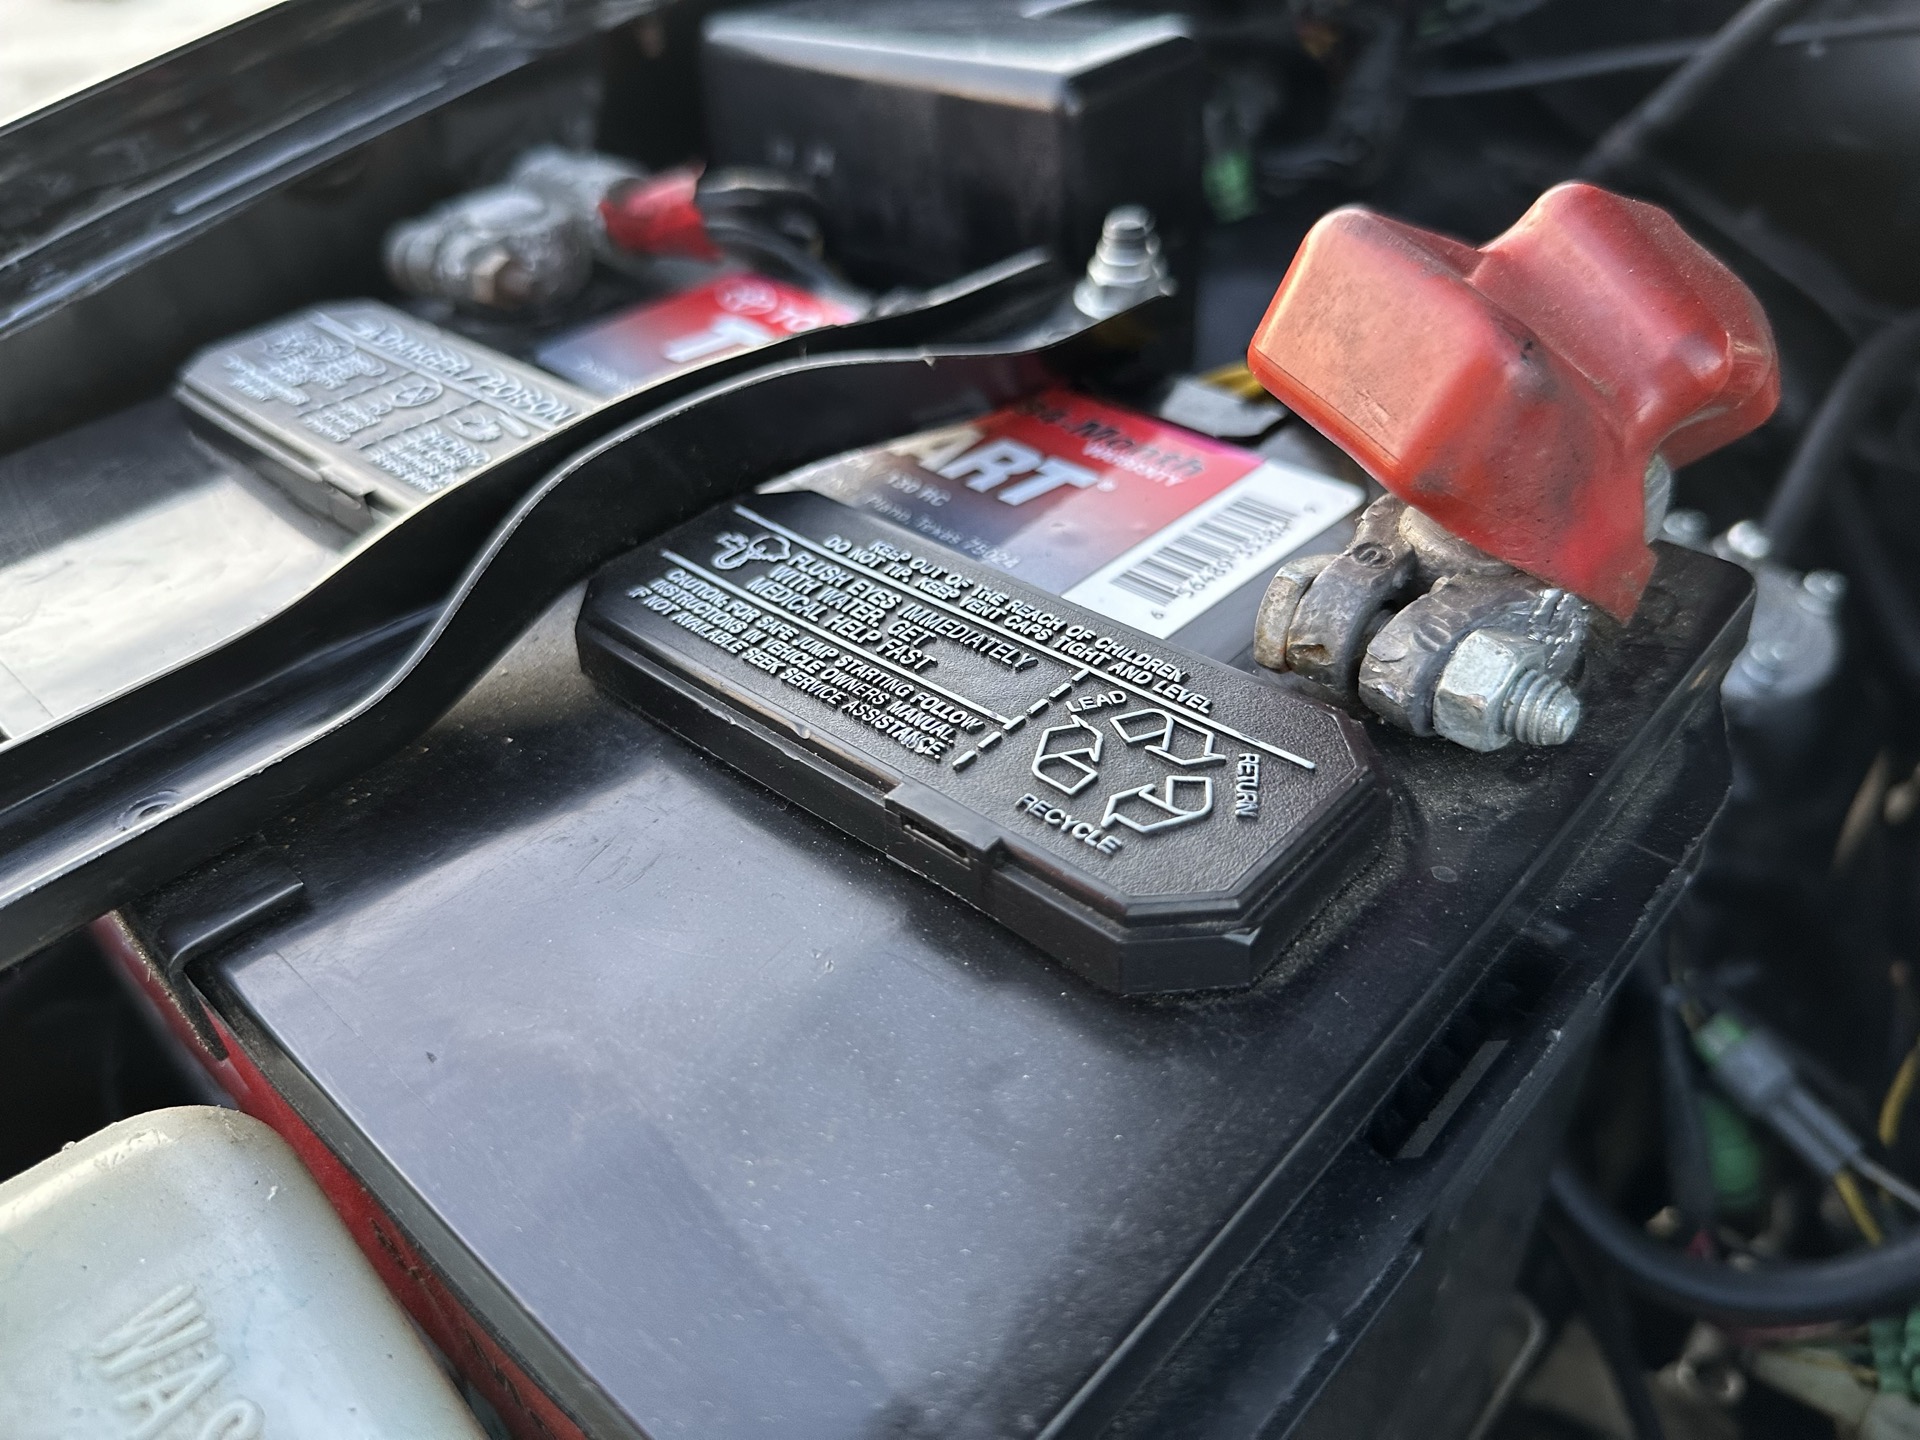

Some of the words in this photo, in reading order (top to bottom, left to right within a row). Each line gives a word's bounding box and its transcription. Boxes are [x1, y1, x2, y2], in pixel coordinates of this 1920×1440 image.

[666, 568, 730, 605] CAUTION:
[726, 599, 761, 623] FOR
[756, 615, 799, 641] SAFE
[792, 632, 839, 659] JUMP
[834, 652, 914, 698] STARTING
[909, 692, 985, 734] FOLLOW
[746, 575, 828, 622] MEDICAL
[824, 614, 883, 644] HELP
[877, 637, 938, 672] FAST
[768, 565, 822, 595] WITH
[817, 588, 887, 628] WATER.
[887, 618, 937, 647] GET
[788, 551, 851, 588] FLUSH
[847, 578, 902, 611] EYES
[897, 602, 1038, 672] IMMEDIATELY
[823, 534, 852, 553] DO
[848, 548, 886, 569] NOT
[883, 562, 911, 583] TIP.
[914, 576, 960, 600] KEEP
[959, 595, 1007, 620] VENT
[1003, 614, 1053, 642] CAPS
[1052, 636, 1111, 667] TIGHT
[1107, 662, 1154, 686] AND
[1151, 680, 1214, 714] LEVEL
[868, 538, 912, 563] KEEP
[909, 556, 948, 580] OUT
[944, 571, 974, 590] OF
[970, 583, 1009, 606] THE
[1006, 599, 1067, 631] REACH
[1065, 624, 1097, 641] OF
[1094, 636, 1190, 683] CHILDREN
[1151, 609, 1165, 620] 6
[626, 583, 652, 599] IF
[643, 594, 680, 616] NOT
[672, 605, 748, 655] AVAILABLE
[742, 647, 786, 675] SEEK
[779, 667, 848, 707] SERVICE
[842, 701, 945, 761] ASSISTANCE.
[650, 578, 748, 634] INSTRUCTIONS
[742, 628, 766, 644] IN
[764, 637, 826, 675] VEHICLE
[820, 668, 890, 706] OWNERS
[886, 700, 956, 744] MANUAL.
[1065, 690, 1128, 713] LEAD
[1015, 793, 1123, 857] RECYCLE
[1234, 752, 1261, 818] RETURN
